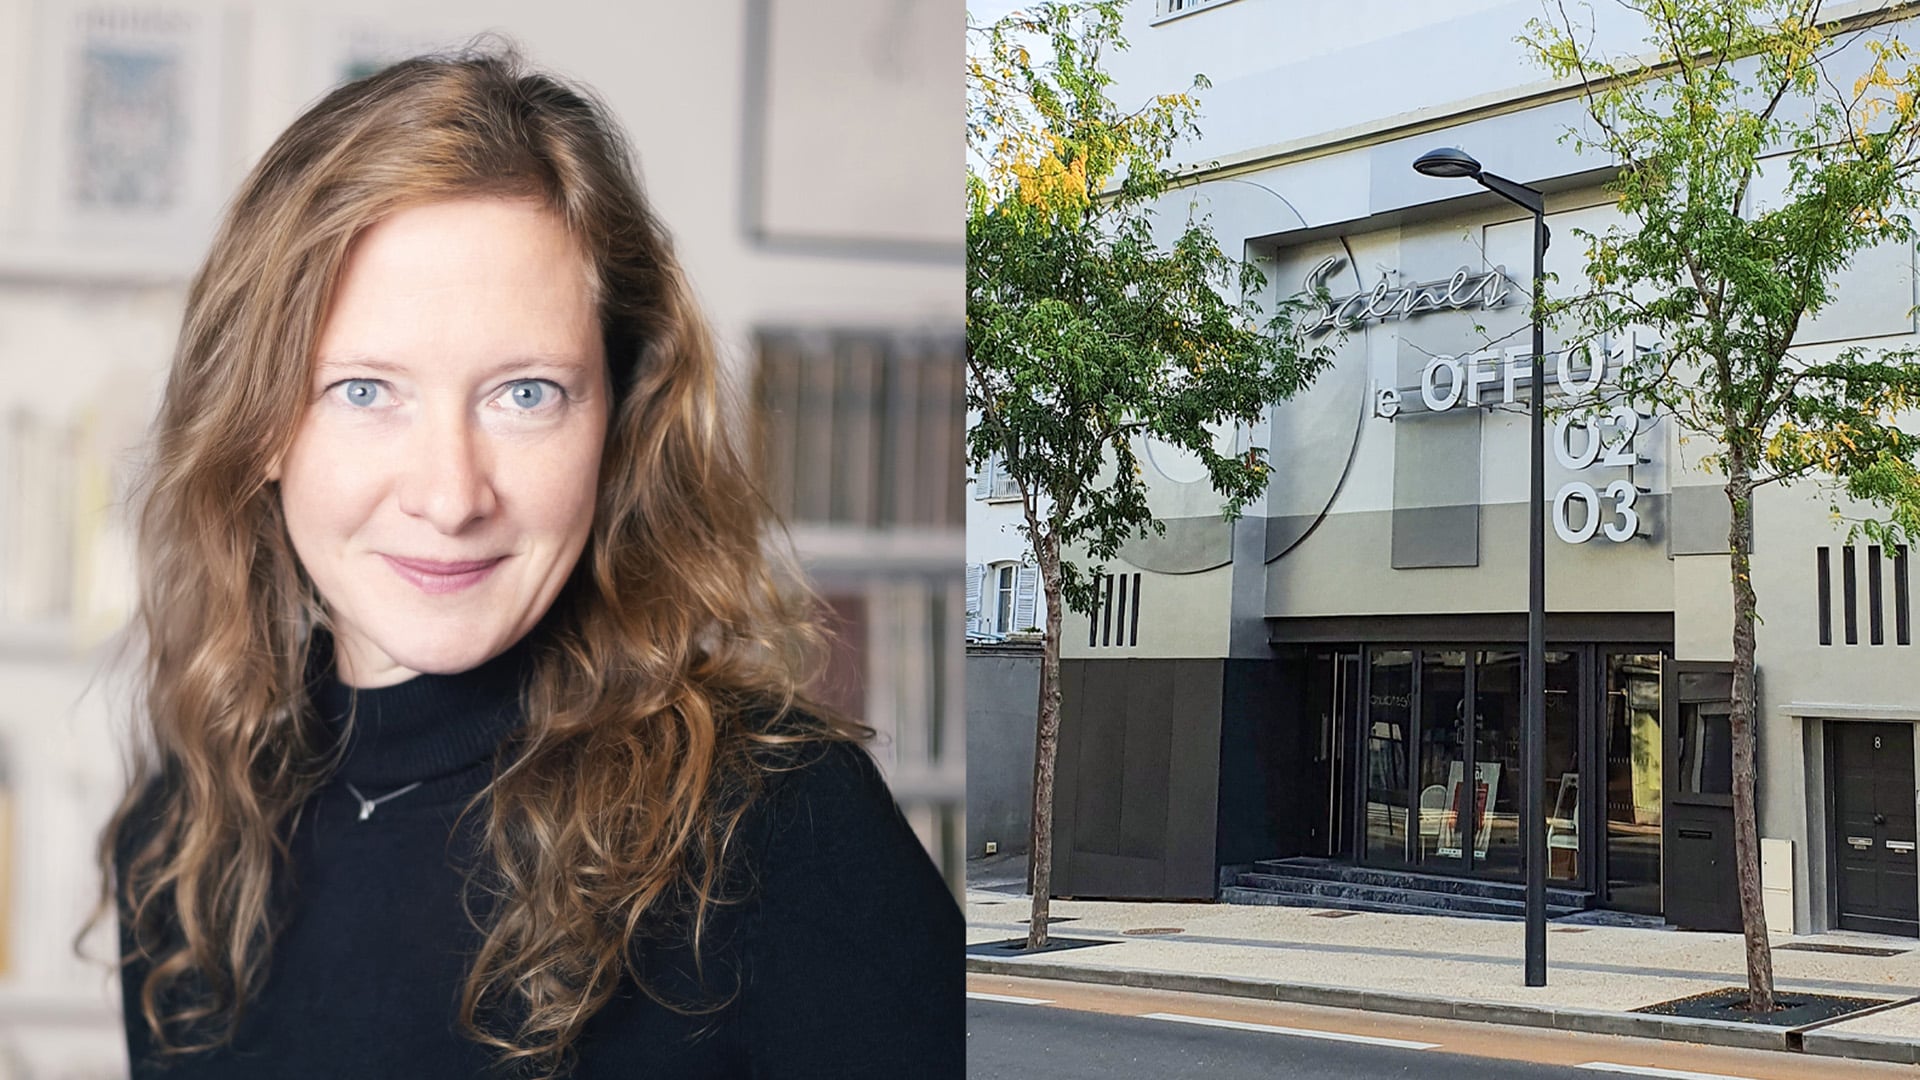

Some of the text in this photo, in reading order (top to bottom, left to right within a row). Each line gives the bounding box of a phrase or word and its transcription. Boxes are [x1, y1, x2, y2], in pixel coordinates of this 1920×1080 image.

[1373, 378, 1401, 419] le
[1421, 345, 1533, 412] OFF
[1874, 737, 1881, 749] 8
